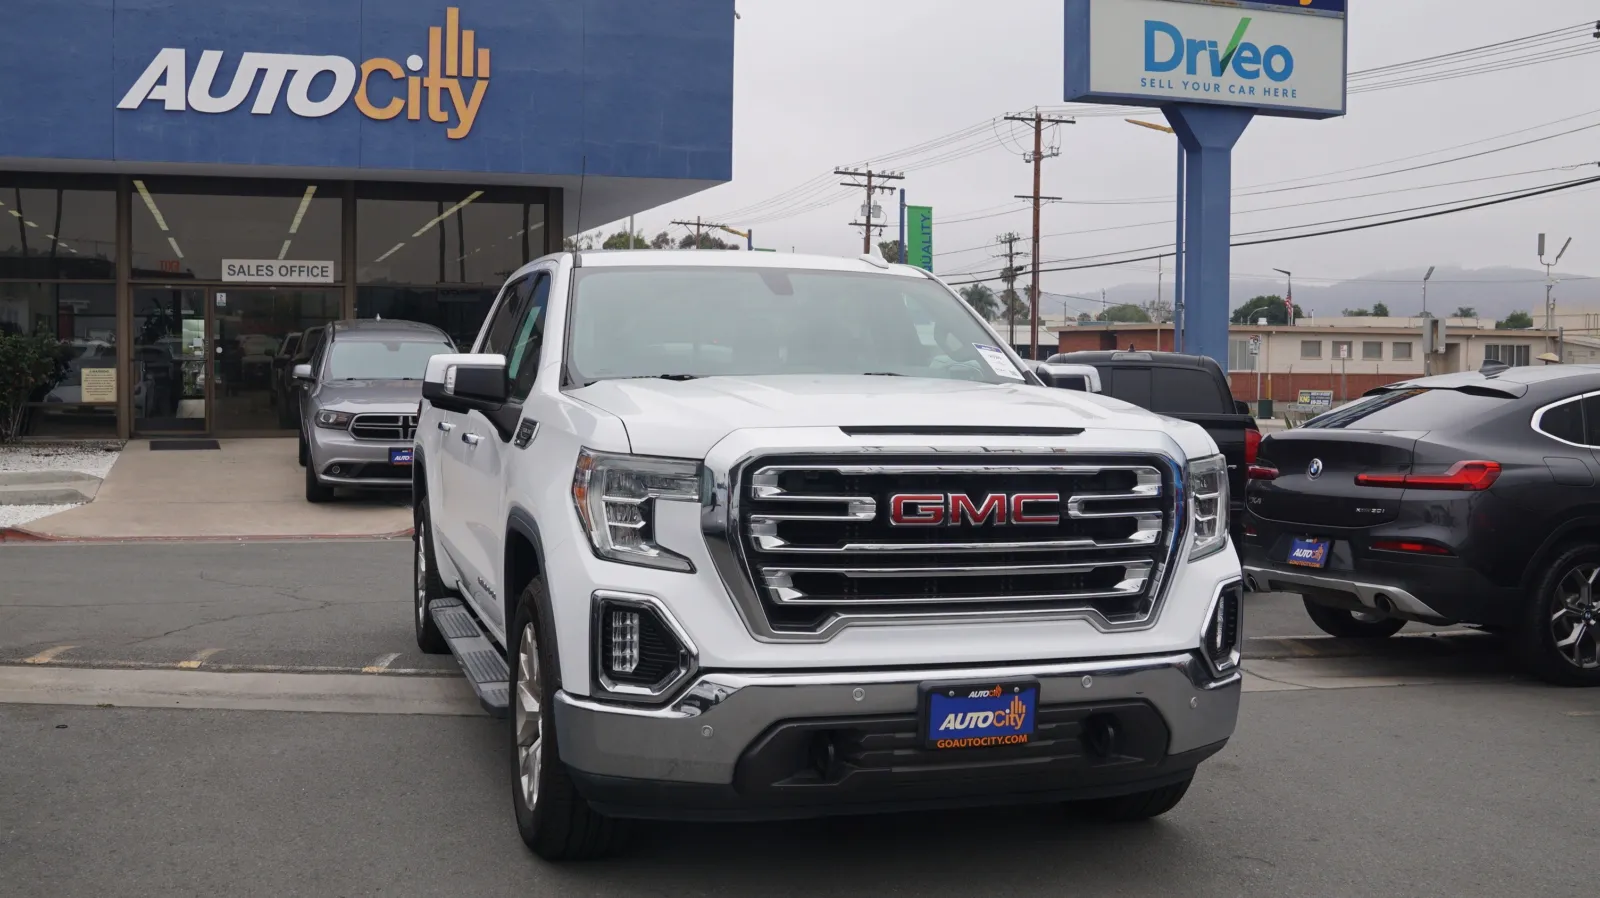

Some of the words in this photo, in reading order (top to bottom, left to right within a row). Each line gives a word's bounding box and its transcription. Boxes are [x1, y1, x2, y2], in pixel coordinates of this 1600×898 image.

[1144, 17, 1294, 82] Driveo
[1141, 78, 1174, 89] SELL
[1182, 81, 1220, 92] YOUR
[1229, 84, 1255, 95] CAR
[1263, 87, 1297, 98] HERE
[227, 264, 274, 277] SALES
[278, 265, 329, 277] OFFICE
[890, 493, 1060, 526] GMC
[937, 734, 1028, 749] GOAUTOCITY.COM
